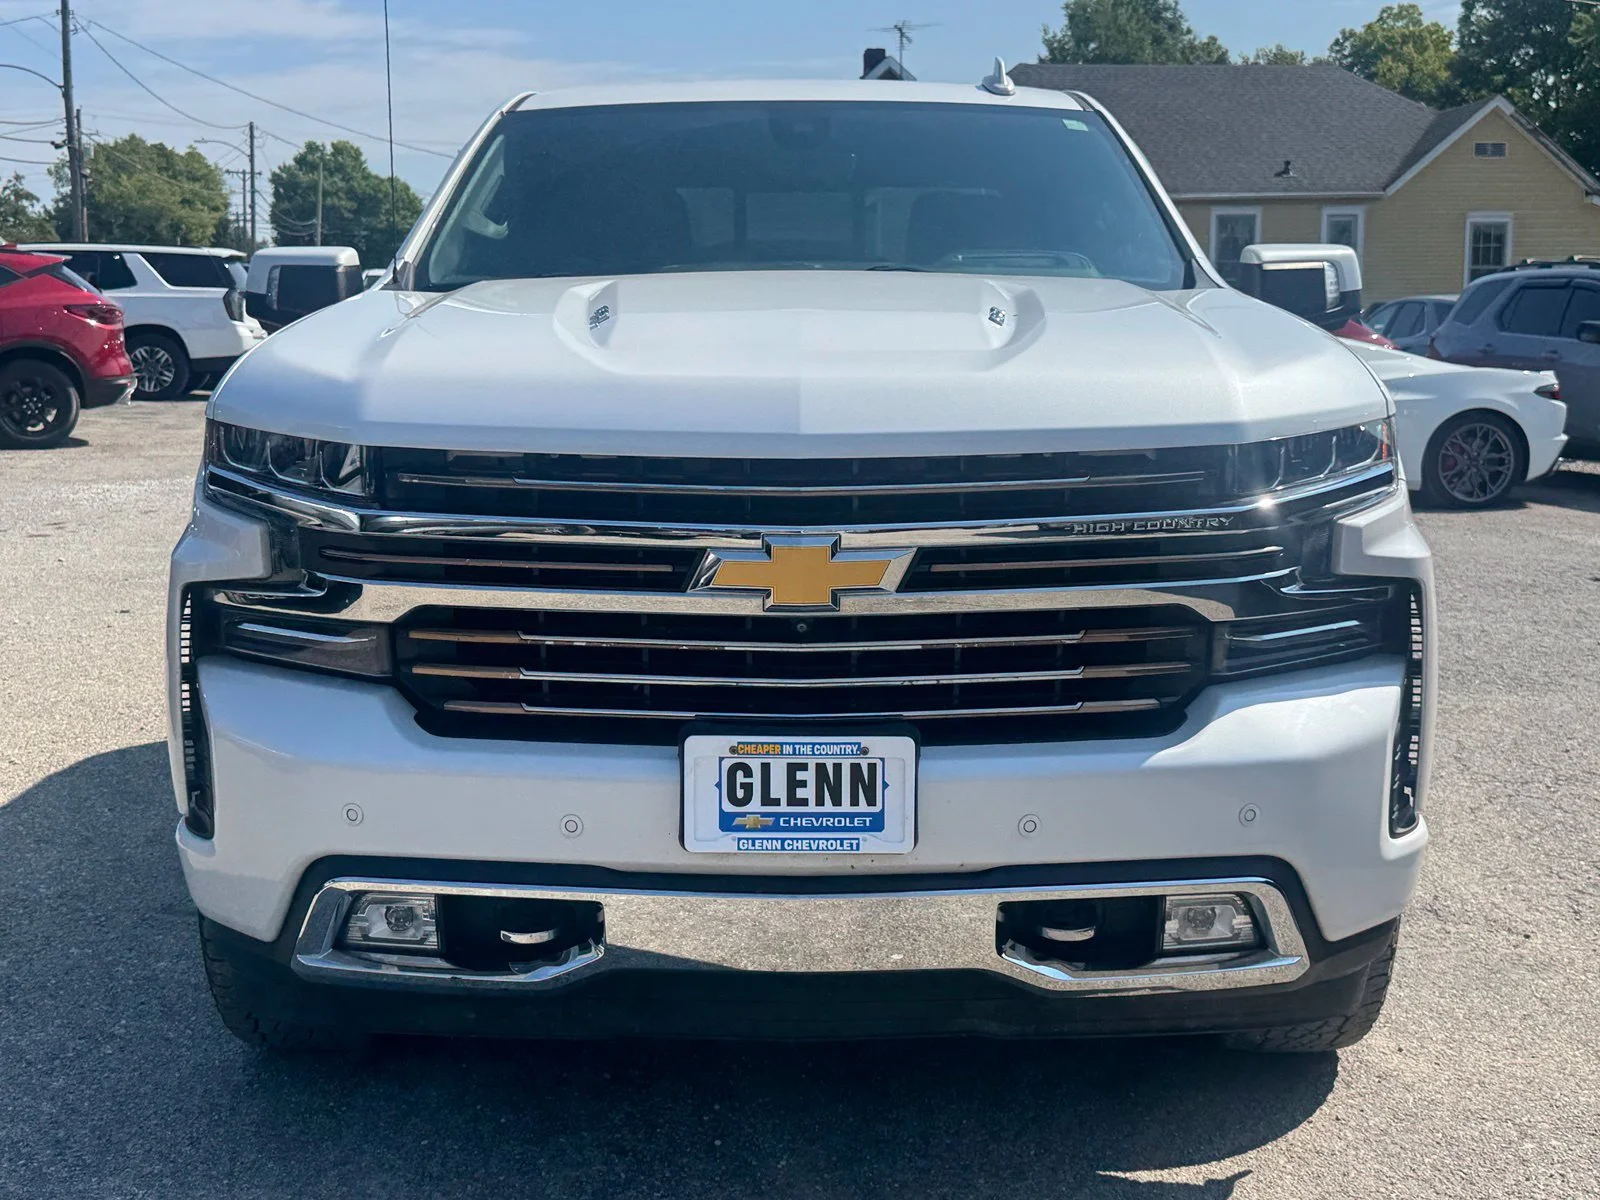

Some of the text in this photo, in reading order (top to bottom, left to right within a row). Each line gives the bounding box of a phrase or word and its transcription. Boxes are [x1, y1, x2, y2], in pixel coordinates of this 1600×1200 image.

[1065, 516, 1234, 534] HIGH COUNTRY
[738, 744, 860, 754] CHEAPER IN THE COUNTRY.
[726, 762, 877, 807] GLENN
[779, 817, 873, 827] CHEVROLET
[739, 839, 859, 850] GLENN CHEVROLET
